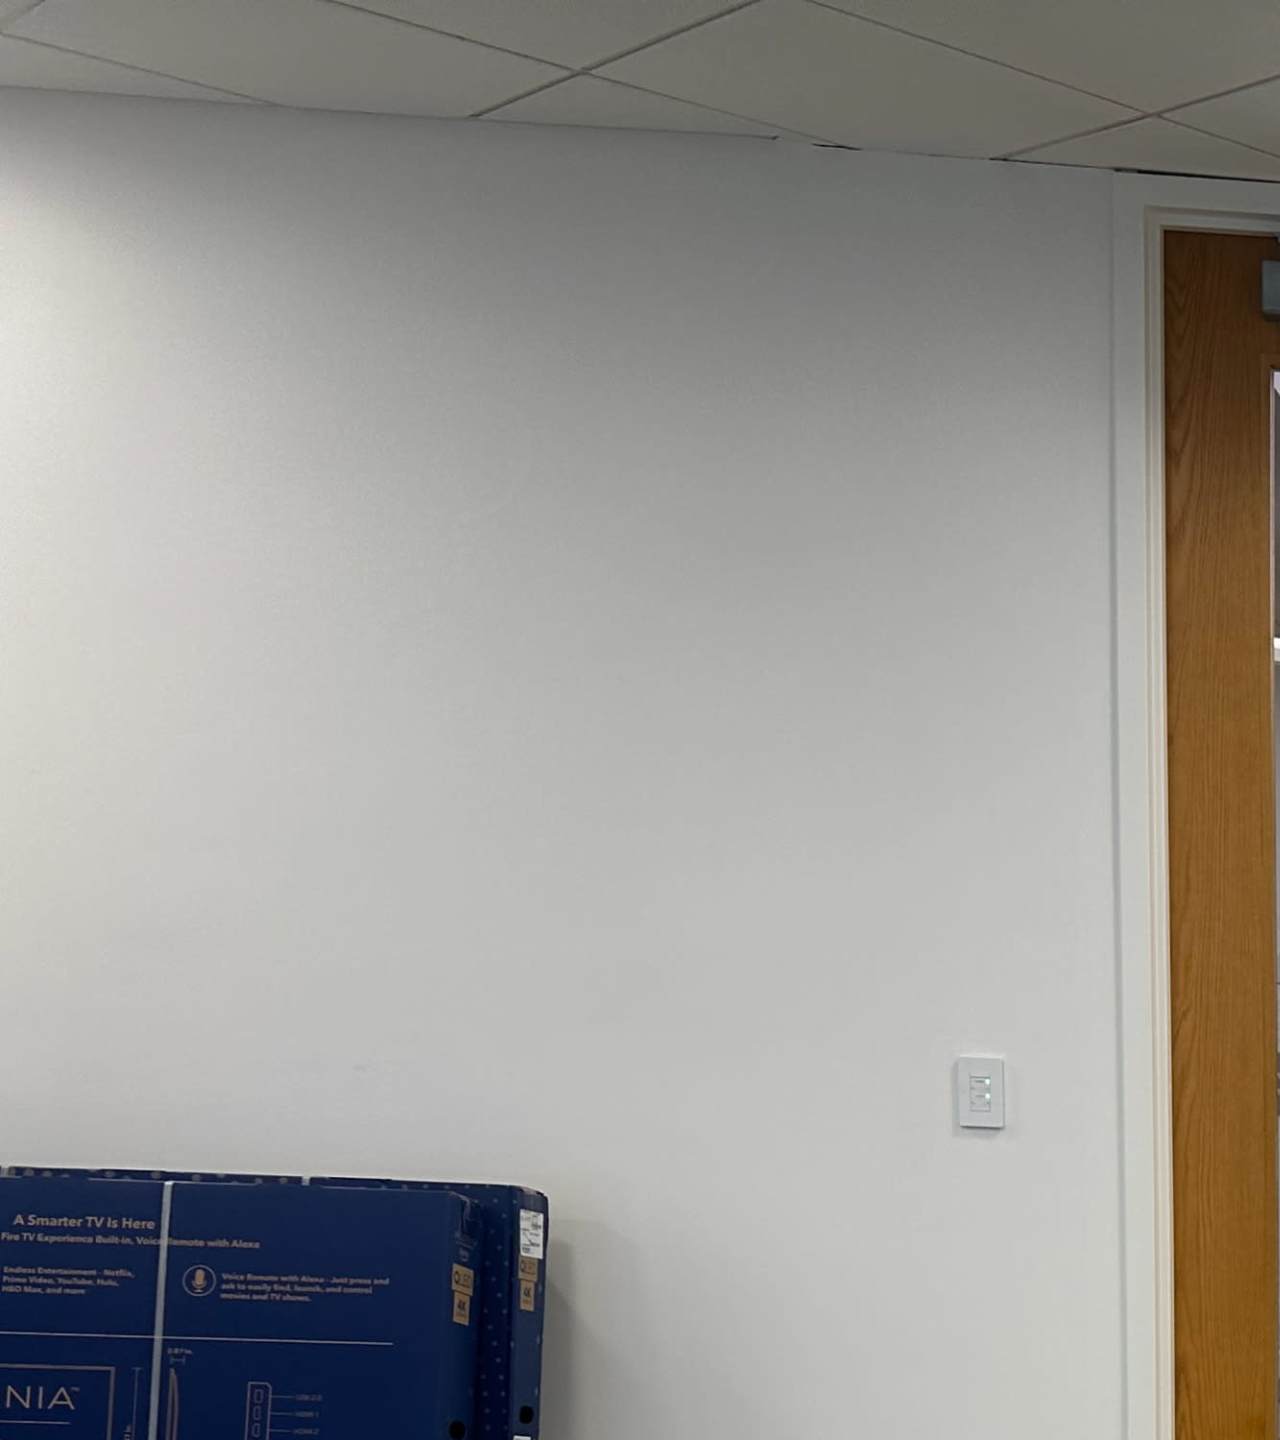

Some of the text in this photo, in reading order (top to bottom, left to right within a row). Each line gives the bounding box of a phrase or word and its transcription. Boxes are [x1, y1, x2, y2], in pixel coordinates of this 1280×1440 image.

[13, 1214, 156, 1230] A Smarter TV Is Here
[1, 1232, 19, 1241] Fire
[22, 1233, 35, 1241] TV
[37, 1234, 93, 1245] Experience
[207, 1239, 229, 1248] with
[231, 1239, 260, 1248] Alexa
